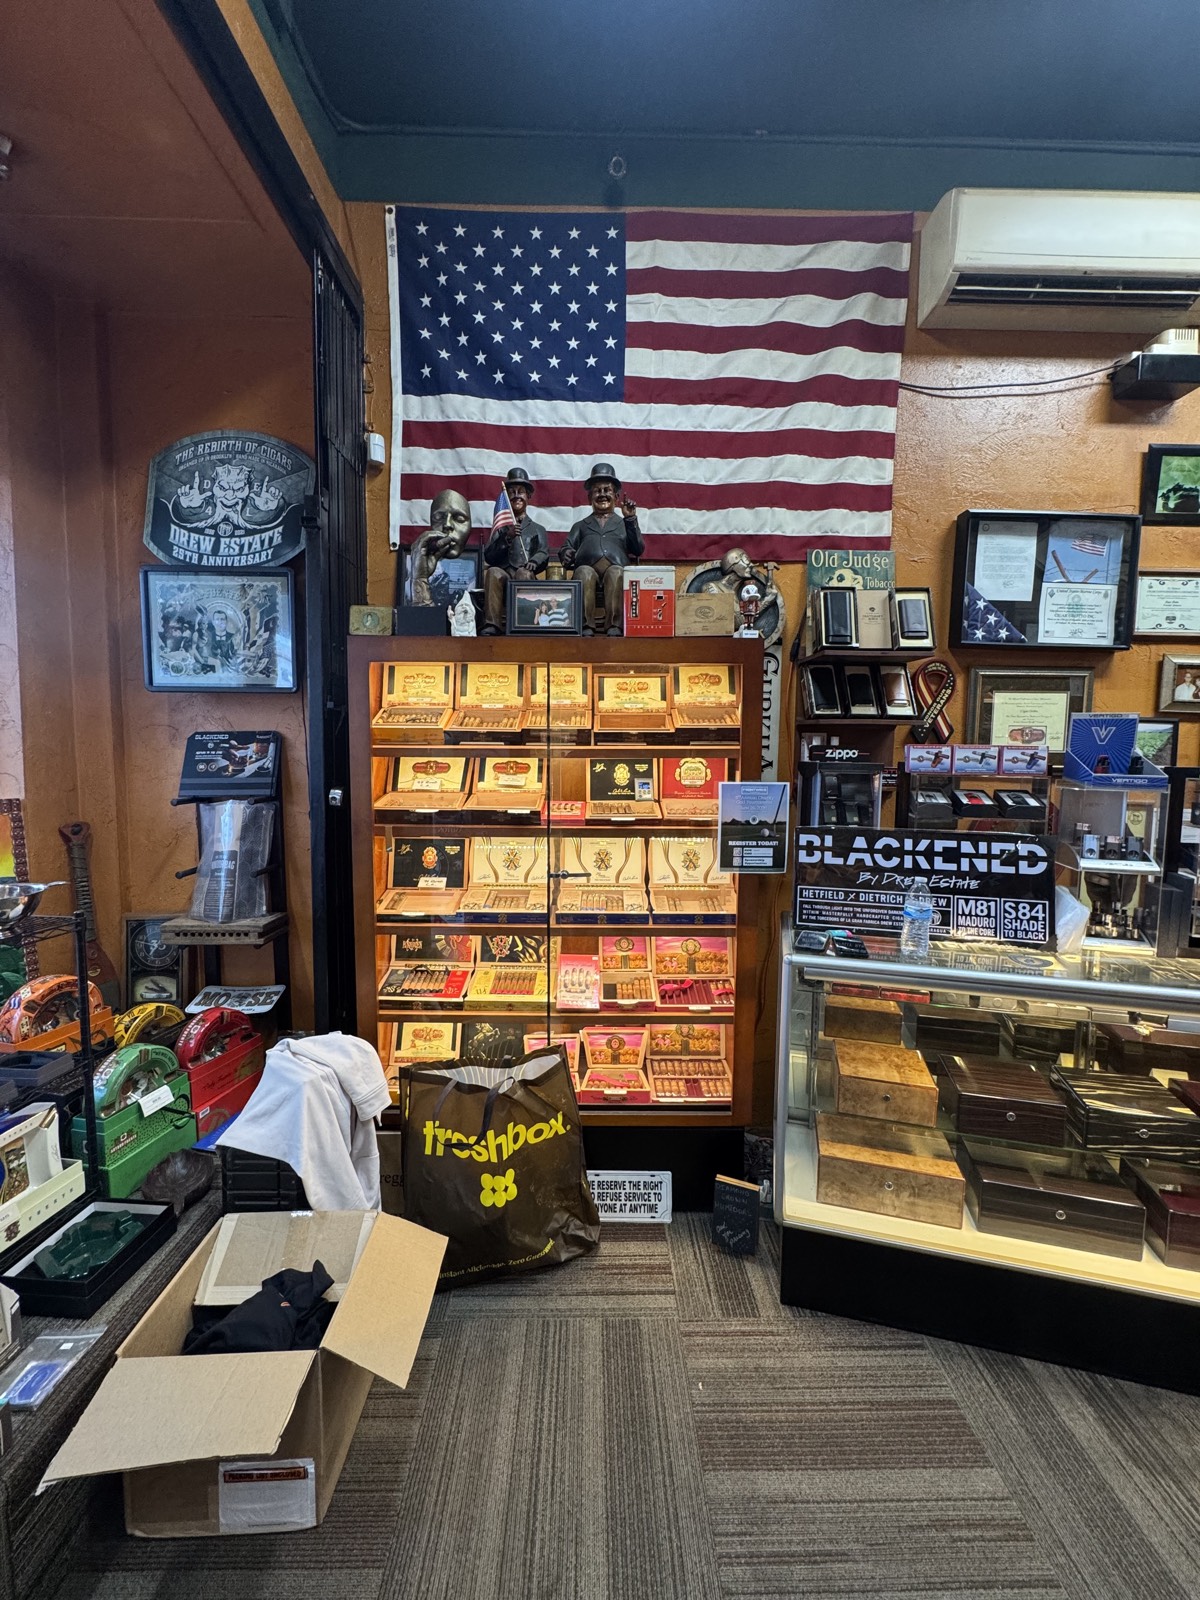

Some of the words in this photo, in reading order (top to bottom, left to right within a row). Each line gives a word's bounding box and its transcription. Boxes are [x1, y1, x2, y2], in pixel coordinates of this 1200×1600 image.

[175, 447, 195, 465] THE
[197, 440, 243, 455] REBIRTH
[245, 442, 258, 453] OF
[261, 446, 293, 471] CIGARS
[168, 523, 215, 555] DREW
[218, 525, 284, 555] ESTATE
[172, 546, 199, 564] 25TH
[201, 548, 274, 567] ANNIVERSARY
[811, 549, 838, 567] Old
[842, 549, 889, 571] Judge
[865, 576, 895, 589] Tobacco
[923, 689, 952, 728] VETERANS
[825, 747, 859, 760] zippo
[798, 833, 1048, 875] BLACKENED
[882, 872, 914, 888] Dre
[802, 889, 845, 900] HETFIELD
[859, 893, 903, 904] DIETRICH
[958, 899, 996, 917] M81
[1004, 901, 1045, 921] S84
[957, 916, 996, 928] MADURO
[1004, 919, 1045, 932] SHADE
[966, 927, 978, 936] THE
[979, 928, 996, 937] CORE
[1004, 929, 1015, 938] TO
[1017, 930, 1045, 940] BLACK
[597, 1181, 627, 1191] RESERVE
[628, 1181, 641, 1191] THE
[643, 1181, 663, 1191] RIGHT
[591, 1192, 595, 1201] O
[597, 1191, 623, 1202] REFUSE
[624, 1192, 651, 1202] SERVICE
[653, 1192, 662, 1203] TO
[595, 1203, 617, 1213] NYONE
[618, 1203, 628, 1214] AT
[628, 1203, 658, 1214] ANYTIME
[439, 1269, 466, 1279] Instant
[508, 1257, 526, 1266] Zero
